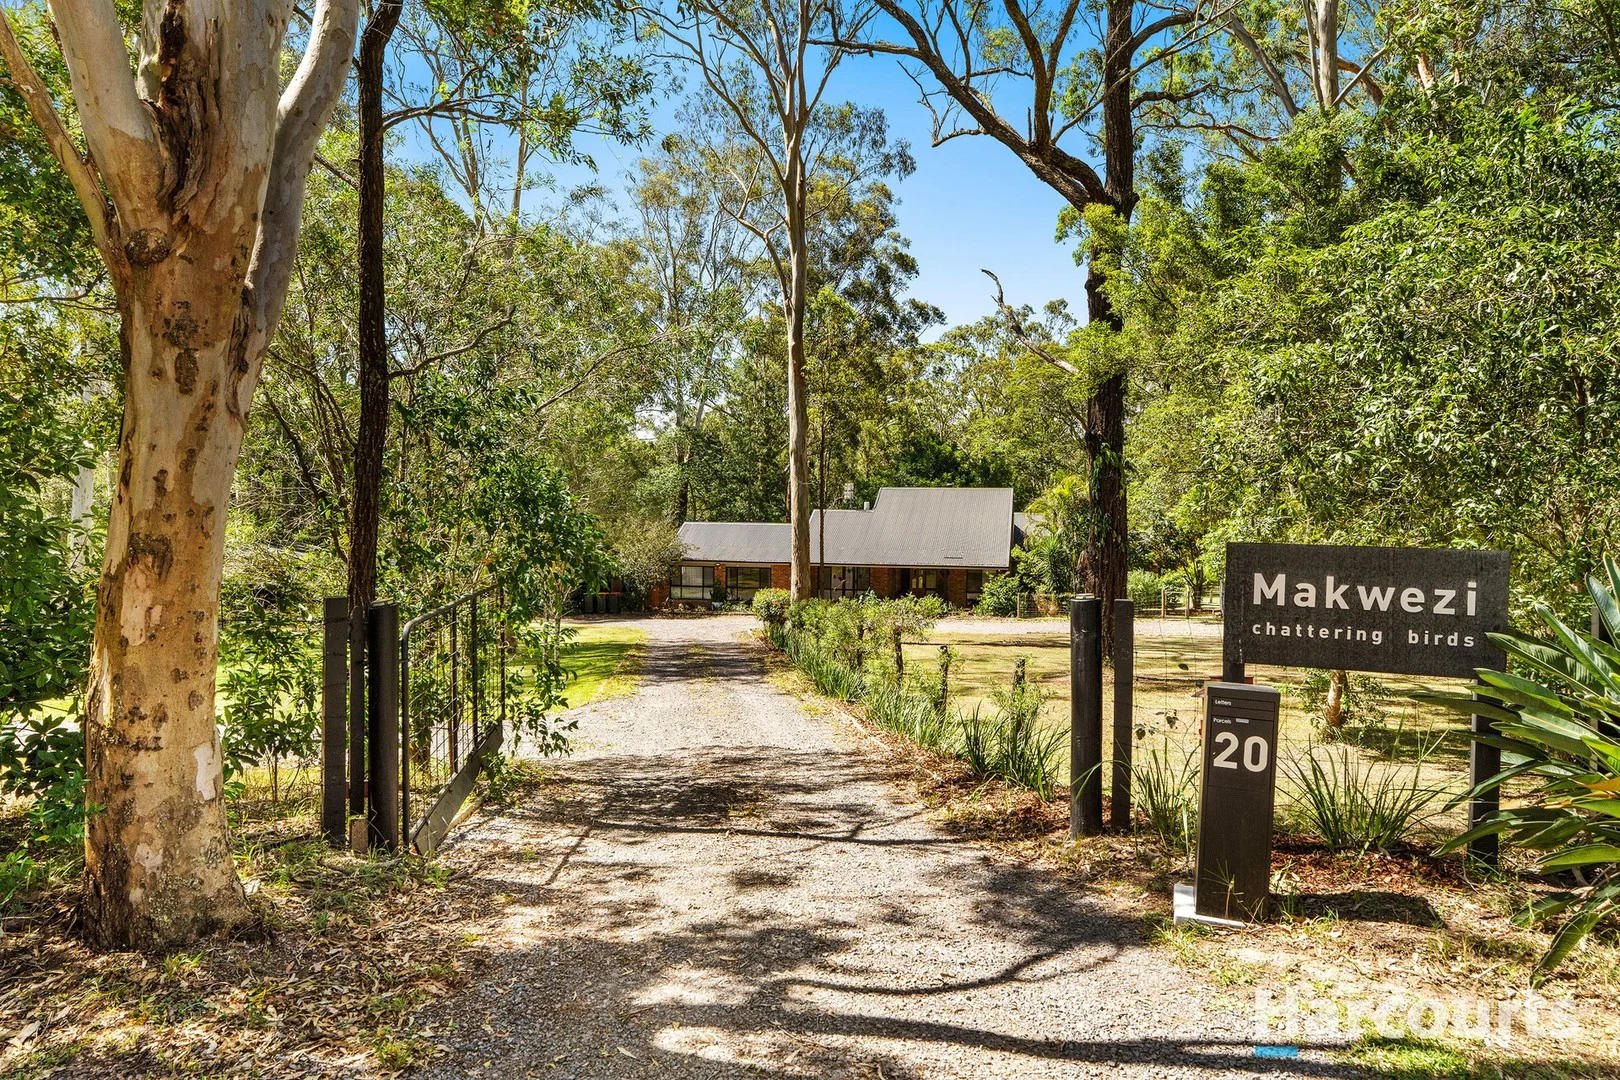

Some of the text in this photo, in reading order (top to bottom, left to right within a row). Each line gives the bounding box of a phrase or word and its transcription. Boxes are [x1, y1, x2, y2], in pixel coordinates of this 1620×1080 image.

[1252, 572, 1477, 617] Makwezi
[1252, 621, 1475, 648] chattering birds
[1213, 731, 1269, 773] 20
